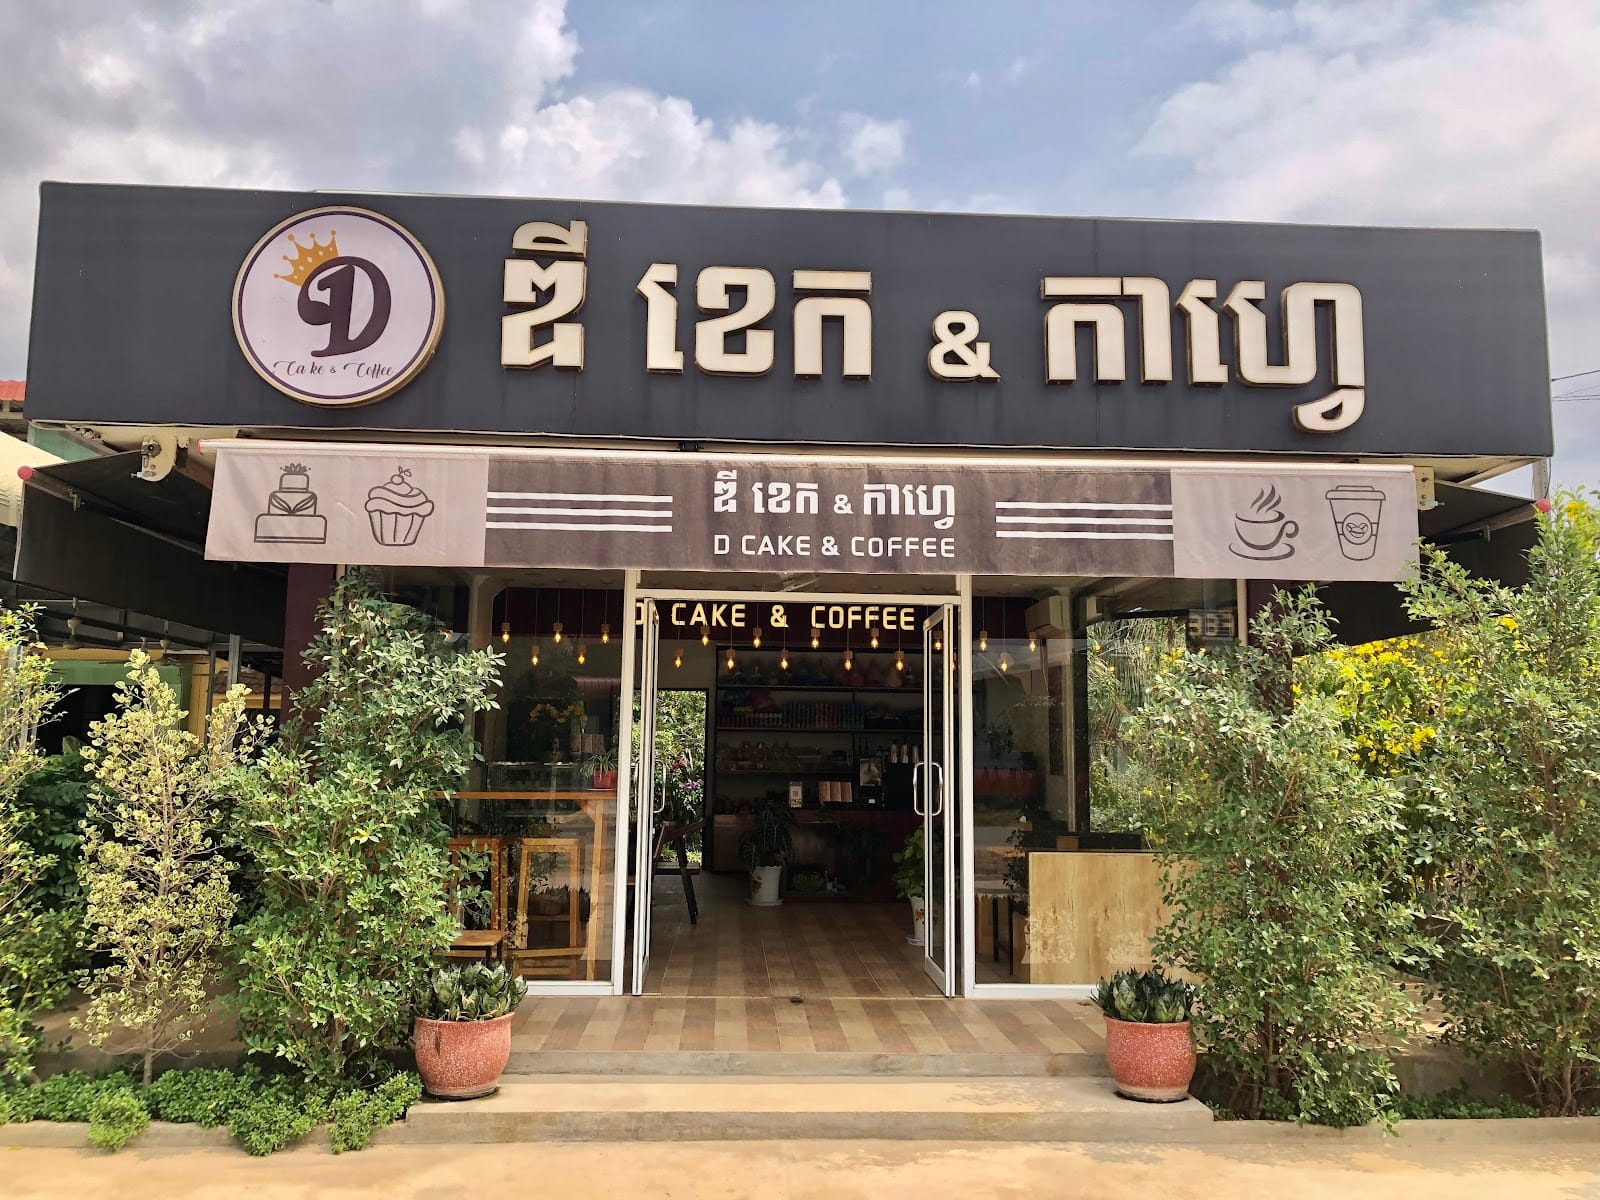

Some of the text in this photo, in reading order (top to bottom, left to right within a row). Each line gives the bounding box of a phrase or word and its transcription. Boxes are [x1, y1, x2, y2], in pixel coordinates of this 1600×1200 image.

[297, 255, 392, 358] D
[636, 263, 872, 379] ខេក
[928, 309, 1001, 383] &
[1041, 275, 1366, 434] កាហ្វេ
[329, 365, 337, 374] &
[343, 362, 393, 379] Coffee
[751, 482, 819, 514] ខេក
[833, 494, 854, 514] &
[863, 483, 956, 530] កាហ្វេ
[713, 534, 955, 558] D CAKE & COFFEE
[671, 603, 746, 628] CAKE
[770, 604, 789, 628] &
[811, 605, 915, 631] COFFEE
